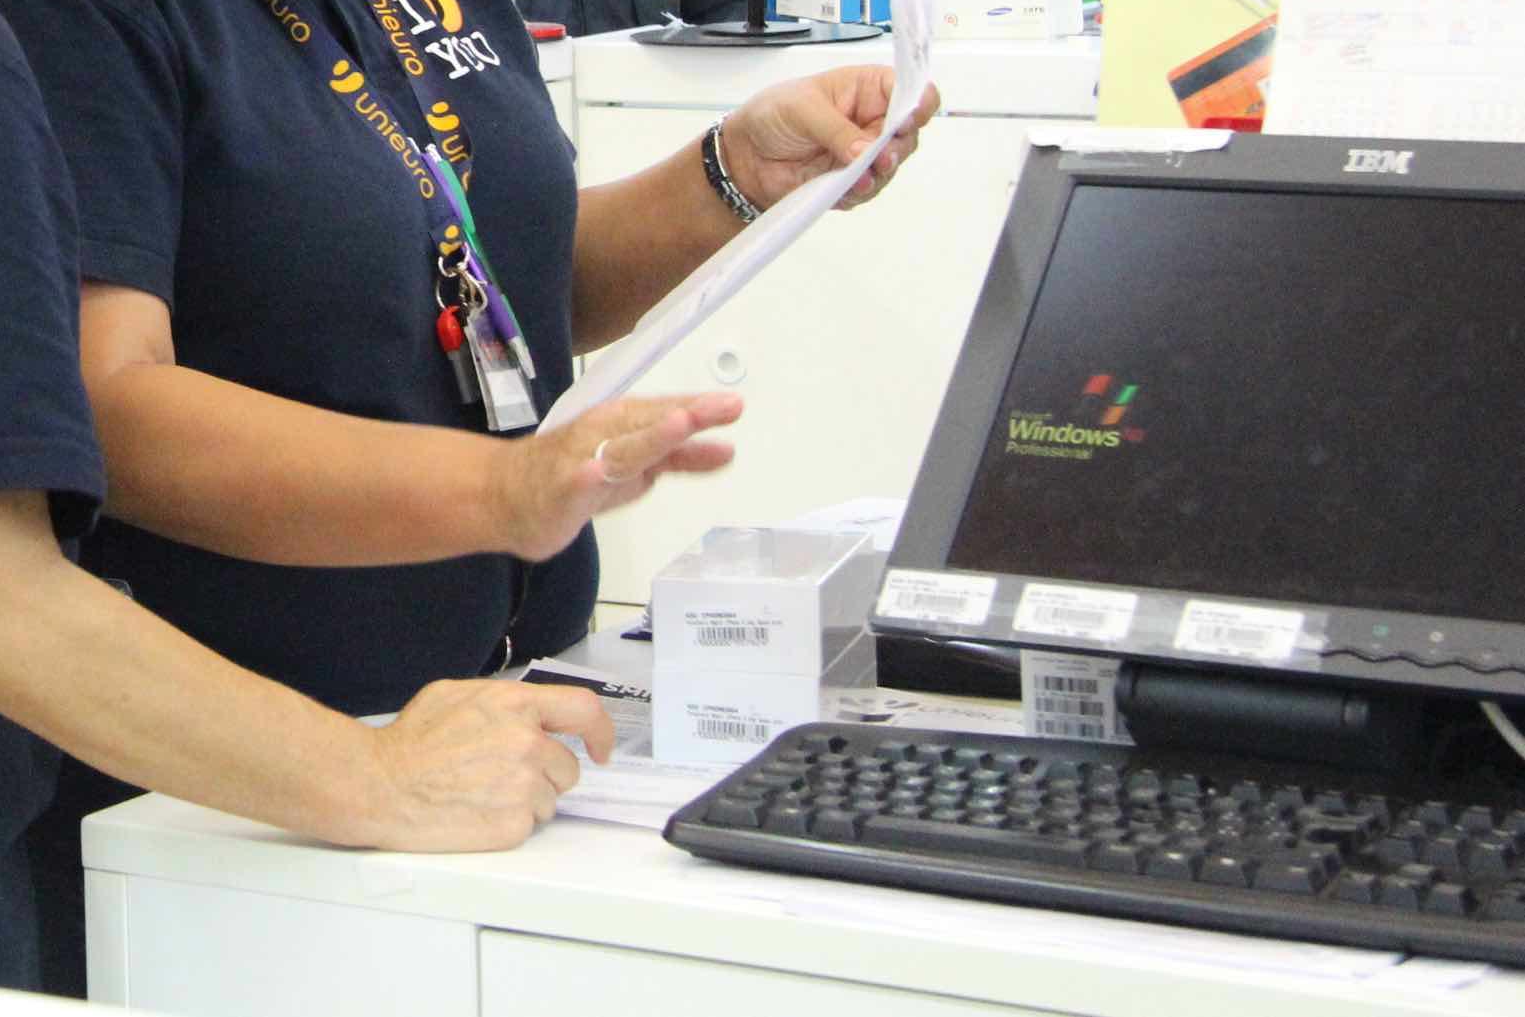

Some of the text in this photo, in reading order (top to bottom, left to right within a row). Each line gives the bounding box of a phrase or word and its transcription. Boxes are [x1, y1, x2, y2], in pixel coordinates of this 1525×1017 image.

[354, 91, 436, 199] unieuro
[1343, 147, 1414, 176] IBM
[1008, 417, 1121, 448] Windows
